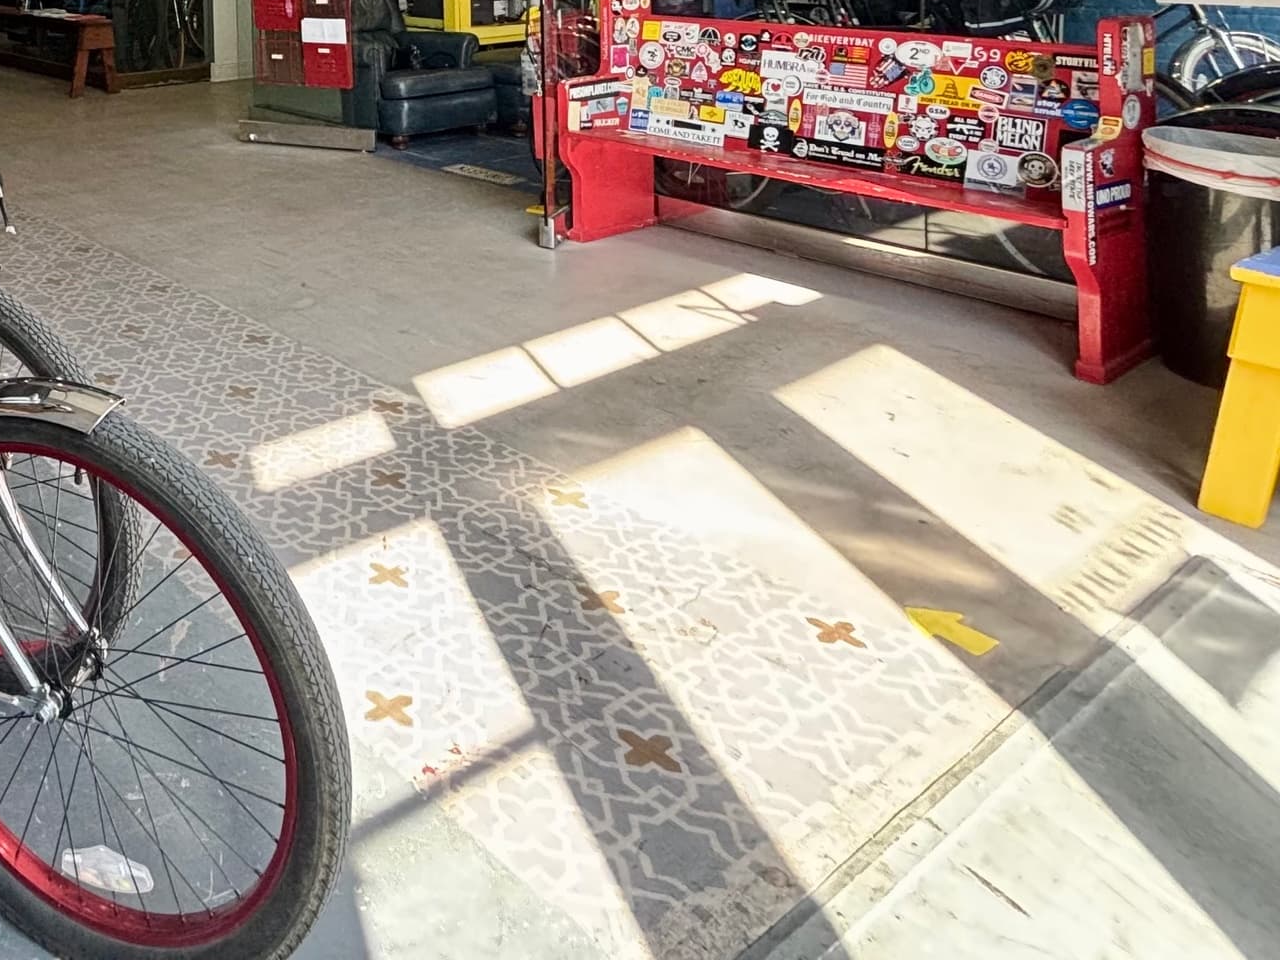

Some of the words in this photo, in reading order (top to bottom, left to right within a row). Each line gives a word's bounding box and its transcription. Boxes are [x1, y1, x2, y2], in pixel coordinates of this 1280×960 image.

[672, 130, 690, 139] AND
[692, 133, 712, 142] TAKE
[998, 116, 1043, 136] BLIND
[996, 130, 1041, 151] MELON
